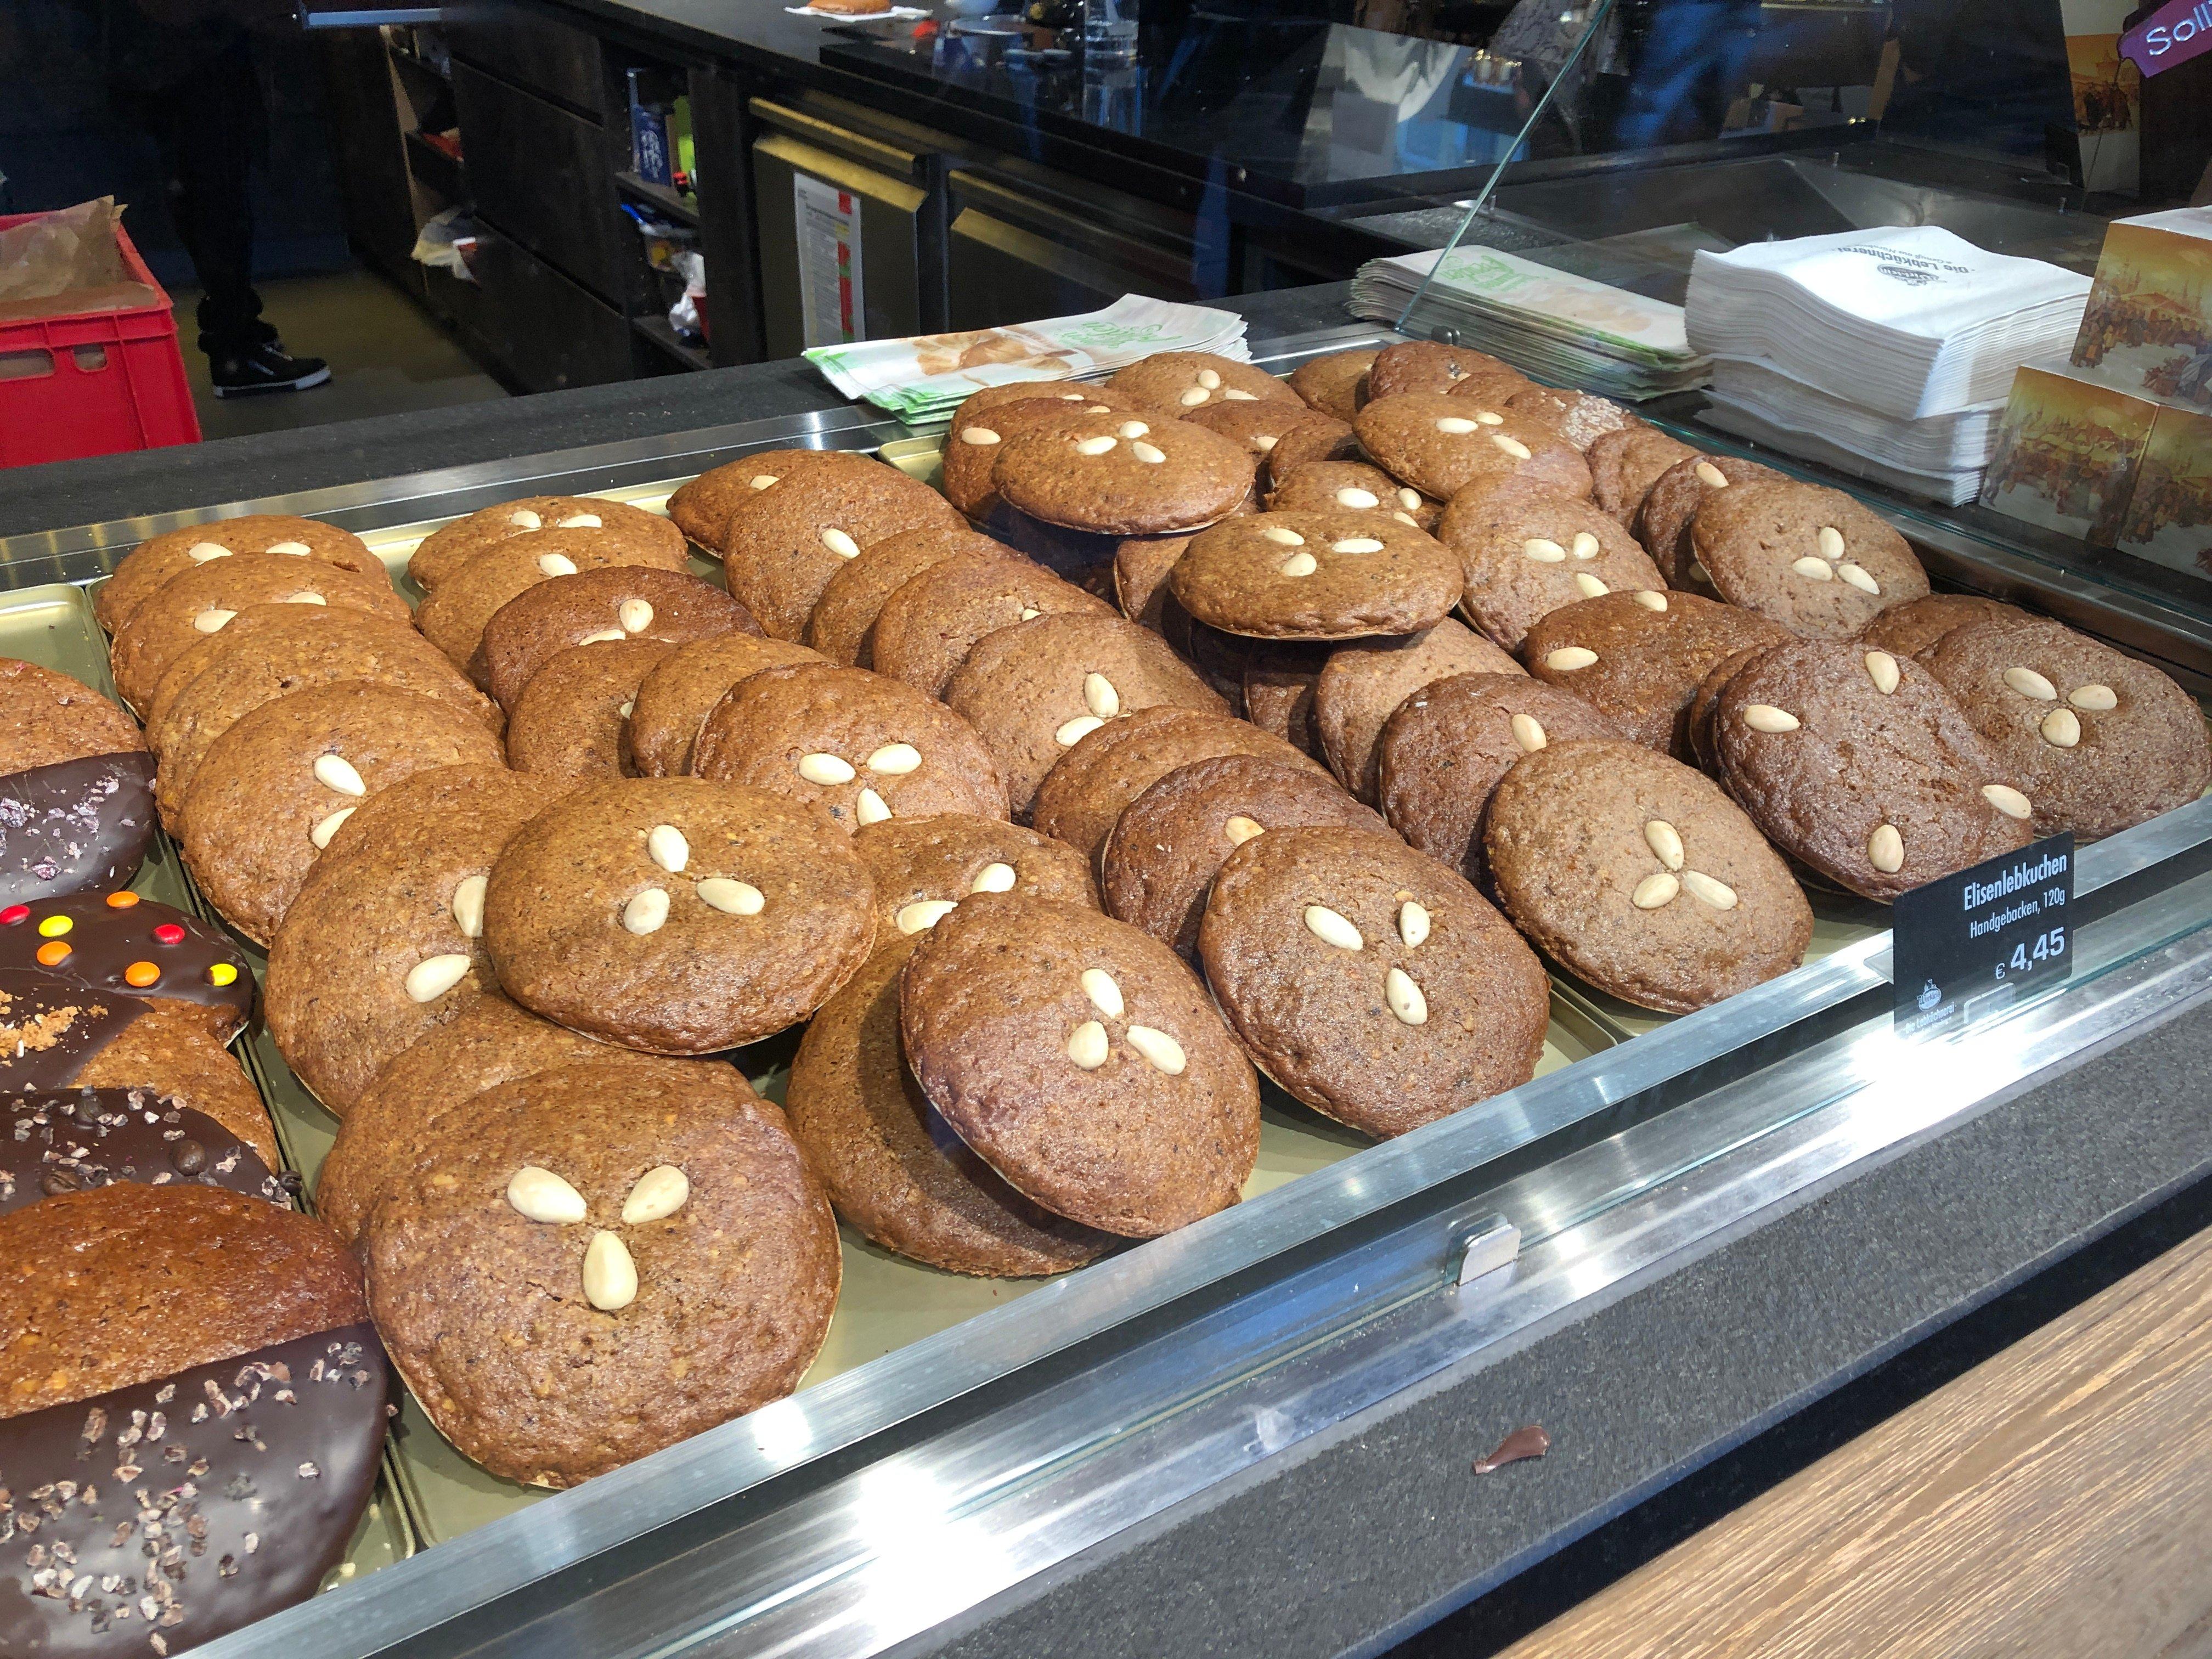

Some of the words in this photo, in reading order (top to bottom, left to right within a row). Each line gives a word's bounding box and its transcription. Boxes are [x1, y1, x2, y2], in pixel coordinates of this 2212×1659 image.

[2146, 0, 2212, 55] Soll
[1964, 854, 2067, 911] Elisenlebkuchen
[1970, 900, 2040, 939] Handgebacken,
[2044, 887, 2065, 908] 120g
[1995, 962, 2005, 980] €
[2011, 927, 2064, 970] 4,45
